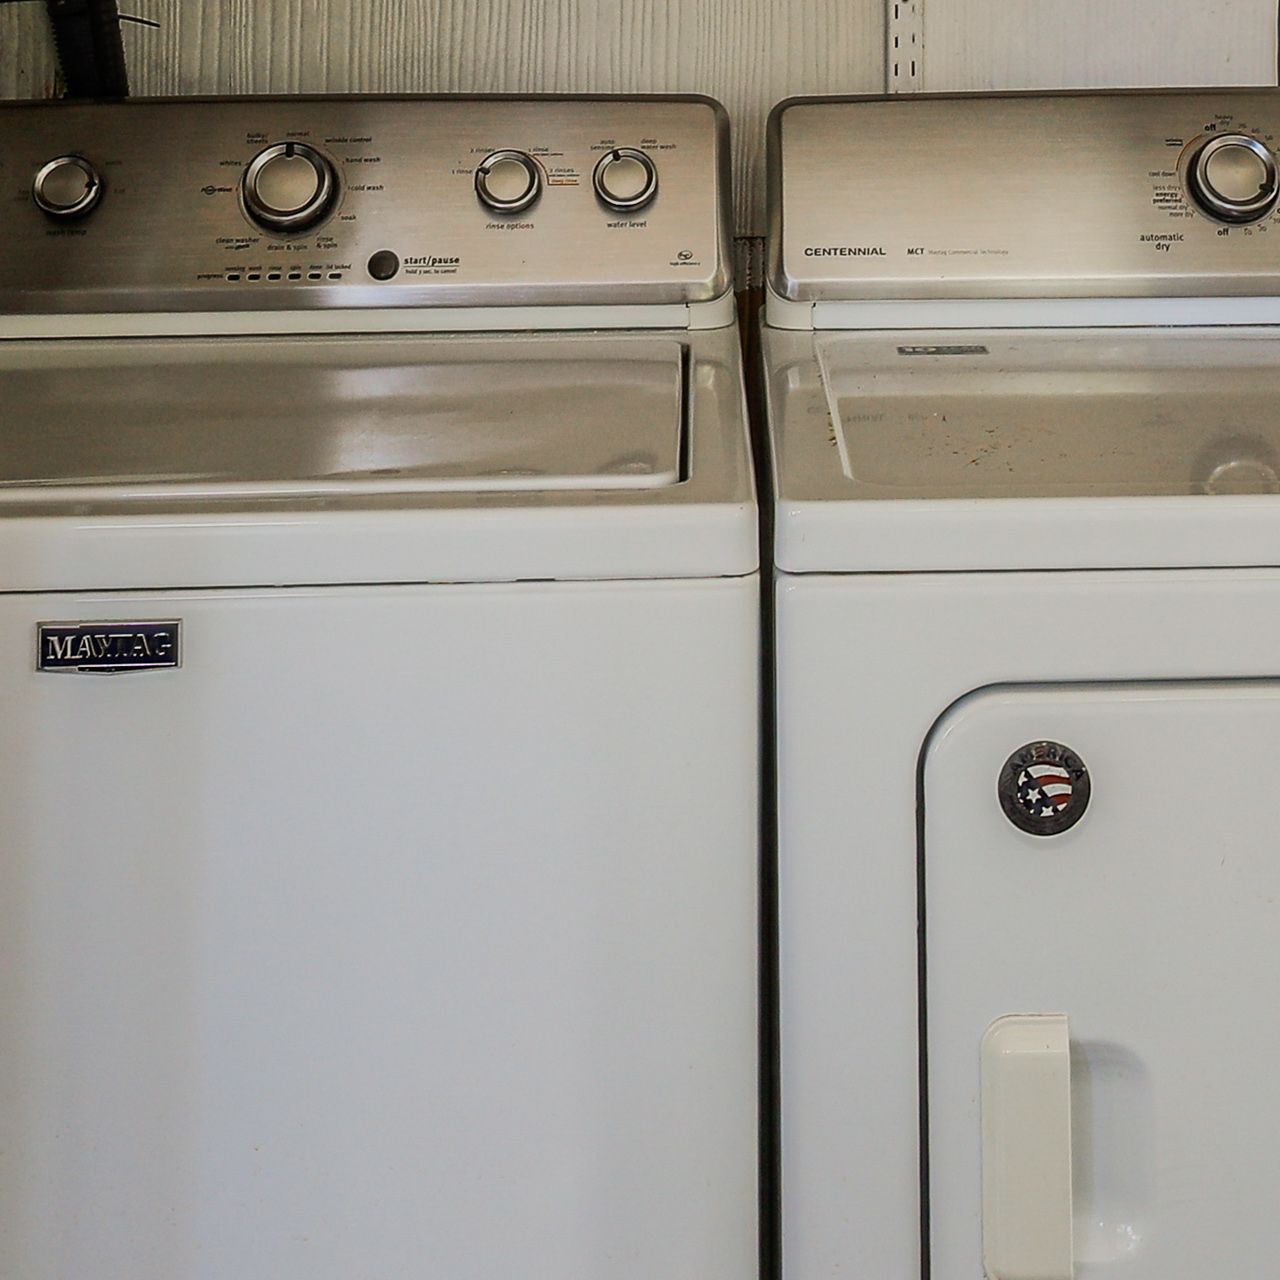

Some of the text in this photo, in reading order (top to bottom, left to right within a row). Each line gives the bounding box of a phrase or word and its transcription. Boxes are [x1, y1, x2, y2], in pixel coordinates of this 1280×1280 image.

[486, 222, 535, 230] rinse options
[1217, 228, 1229, 236] off
[1140, 233, 1184, 242] automatic
[804, 247, 886, 257] CENTENNIAL
[1155, 242, 1170, 252] dry
[404, 256, 460, 267] start/pause
[46, 632, 172, 659] MAYTAG
